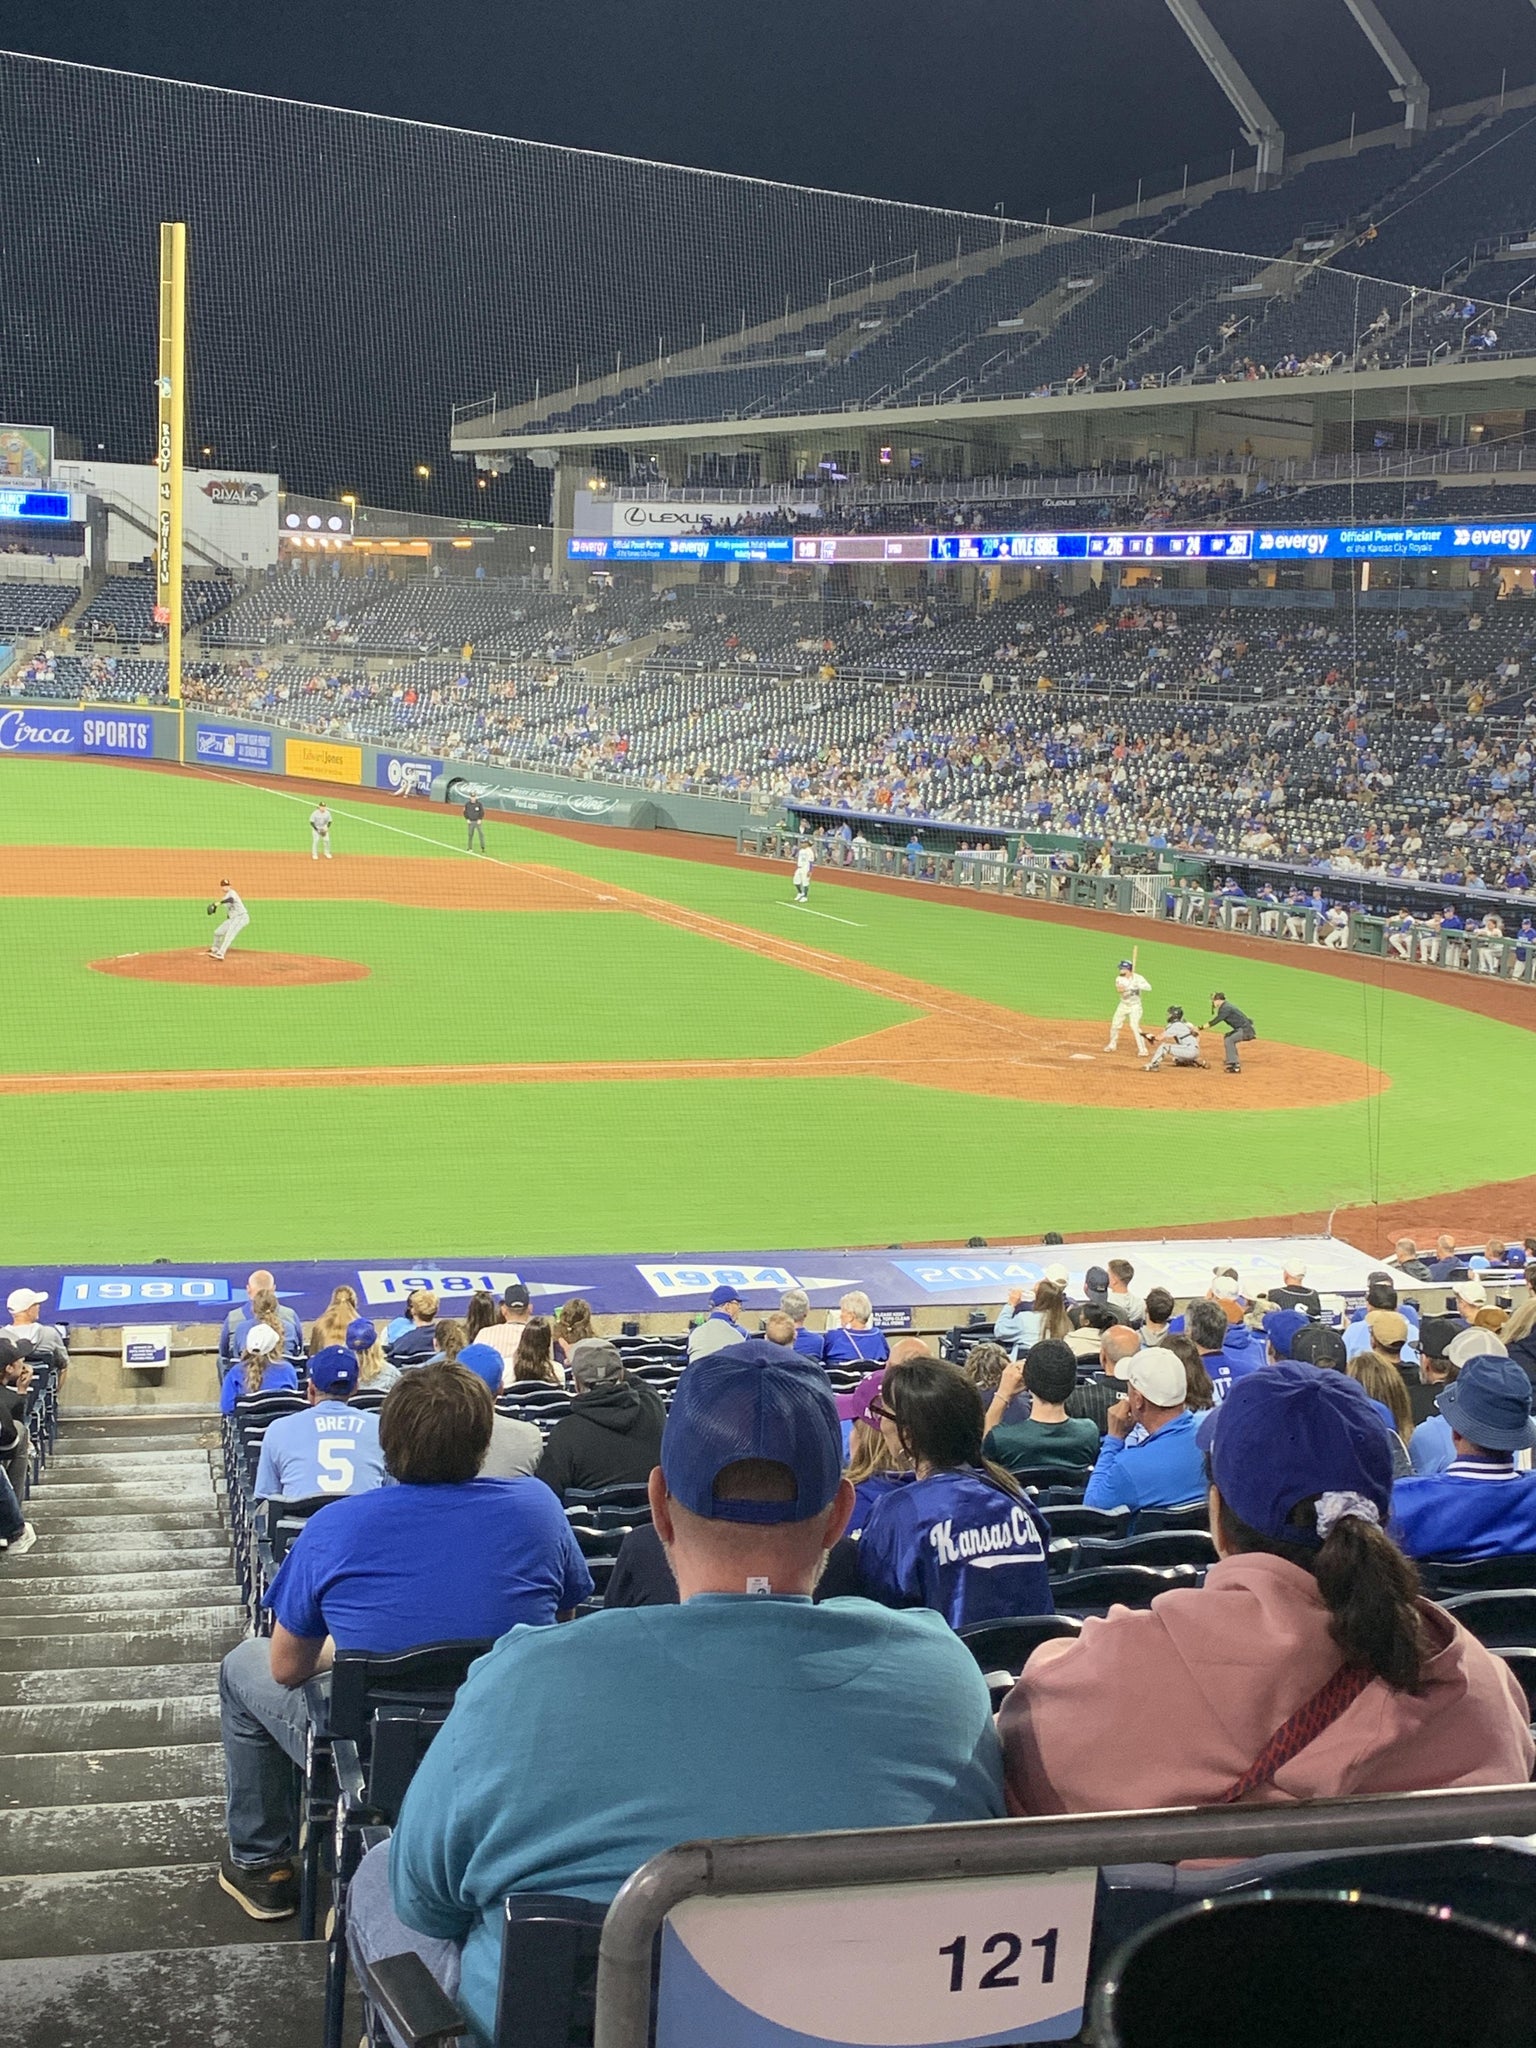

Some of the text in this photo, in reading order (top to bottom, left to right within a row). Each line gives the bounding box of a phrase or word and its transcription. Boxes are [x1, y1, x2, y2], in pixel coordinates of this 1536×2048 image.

[212, 488, 258, 502] RIVALS
[649, 513, 712, 524] LEXUS
[1275, 534, 1328, 554] evergy
[1340, 530, 1442, 542] Official Power Partner
[1471, 529, 1532, 550] evergy
[580, 541, 607, 557] evergy
[679, 541, 709, 557] evergy
[1011, 537, 1033, 556] KYLE
[1186, 537, 1200, 555] 24
[0, 710, 147, 749] Circa SPORTS
[653, 1269, 787, 1287] 1984
[914, 1264, 1035, 1283] 2014
[75, 1281, 215, 1300] 1980
[380, 1275, 495, 1293] 1981
[314, 1415, 366, 1433] BRETT
[317, 1438, 356, 1492] 5
[930, 1519, 1014, 1566] Kansas
[939, 1928, 1058, 1992] 121
